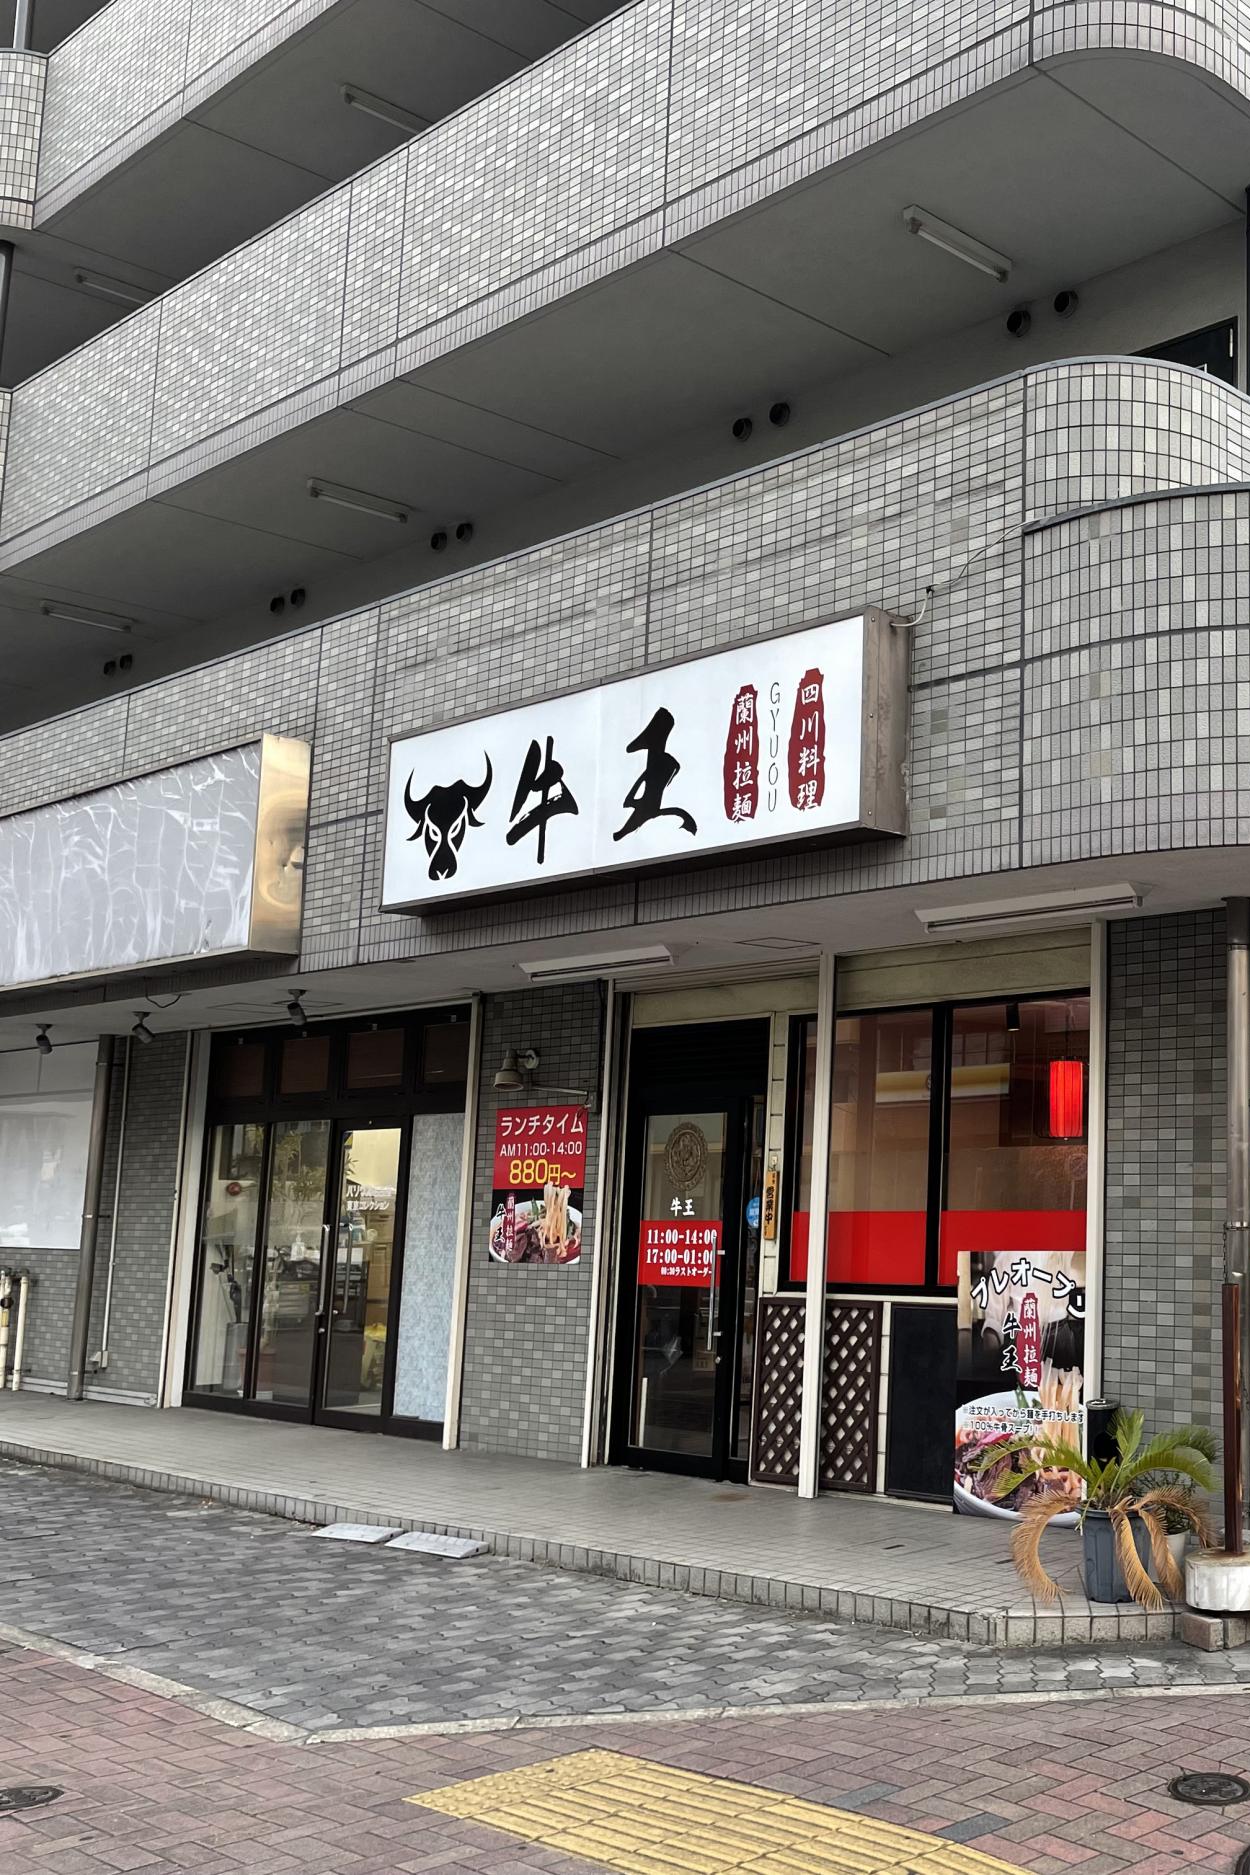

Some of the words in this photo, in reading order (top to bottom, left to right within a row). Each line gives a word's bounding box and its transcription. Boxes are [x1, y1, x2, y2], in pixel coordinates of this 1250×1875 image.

[767, 682, 781, 812] GYUOU
[797, 683, 821, 810] 四川料理
[506, 707, 698, 865] 牛王
[501, 1112, 584, 1137] ランチタイム
[647, 1228, 718, 1245] 11:00-14:00
[670, 1196, 695, 1217] 牛王
[970, 1257, 1085, 1320] プレオープン
[1000, 1311, 1023, 1374] 牛王
